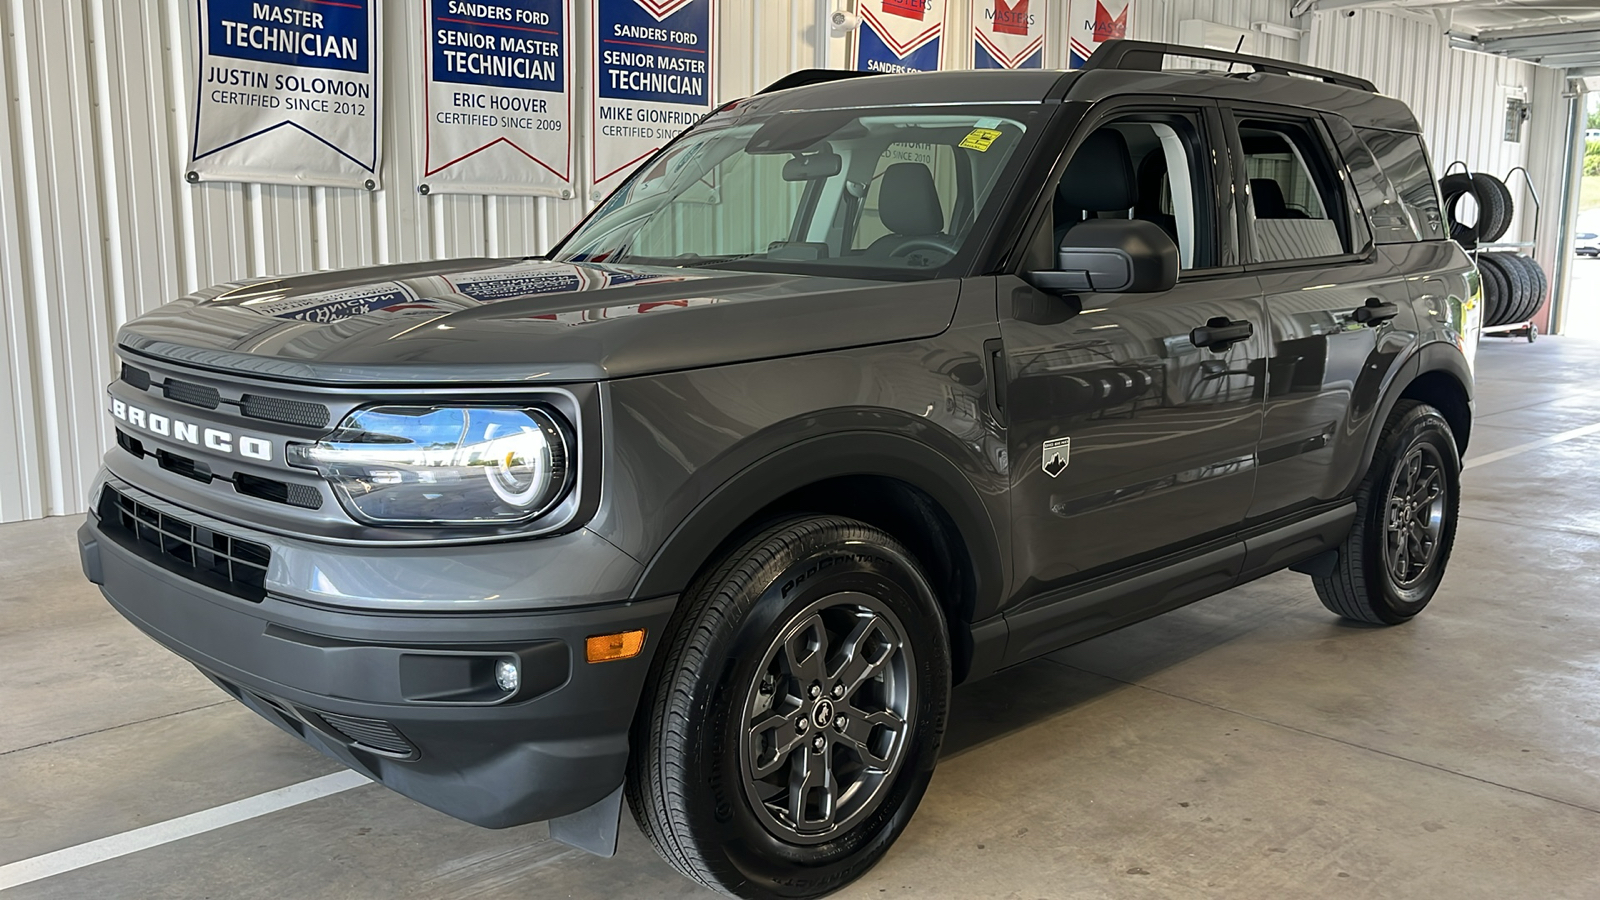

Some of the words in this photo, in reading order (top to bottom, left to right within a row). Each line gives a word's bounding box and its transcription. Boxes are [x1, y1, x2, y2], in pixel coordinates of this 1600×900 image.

[253, 3, 323, 29] MASTER
[448, 1, 512, 21] SANDERS
[515, 9, 549, 25] FORD
[985, 8, 1035, 26] MASTERS
[222, 20, 357, 60] TECHNICIAN
[437, 30, 496, 50] SENIOR
[501, 37, 559, 57] MASTER
[614, 24, 667, 41] SANDERS
[670, 30, 698, 45] FORD
[443, 50, 555, 81] TECHNICIAN
[603, 50, 655, 69] SENIOR
[657, 56, 705, 73] MASTER
[208, 67, 268, 89] JUSTIN
[275, 75, 369, 98] SOLOMON
[608, 69, 702, 96] TECHNICIAN
[211, 90, 280, 108] CERTIFIED
[285, 97, 329, 112] SINCE
[333, 102, 366, 116] 2012
[453, 92, 486, 109] ERIC
[490, 95, 547, 113] HOOVER
[600, 106, 633, 121] MIKE
[436, 112, 498, 127] CERTIFIED
[501, 116, 533, 130] SINCE
[536, 118, 562, 132] 2009
[602, 125, 654, 139] CERTIFIED
[914, 153, 931, 164] 2010
[113, 398, 273, 461] BRONCO
